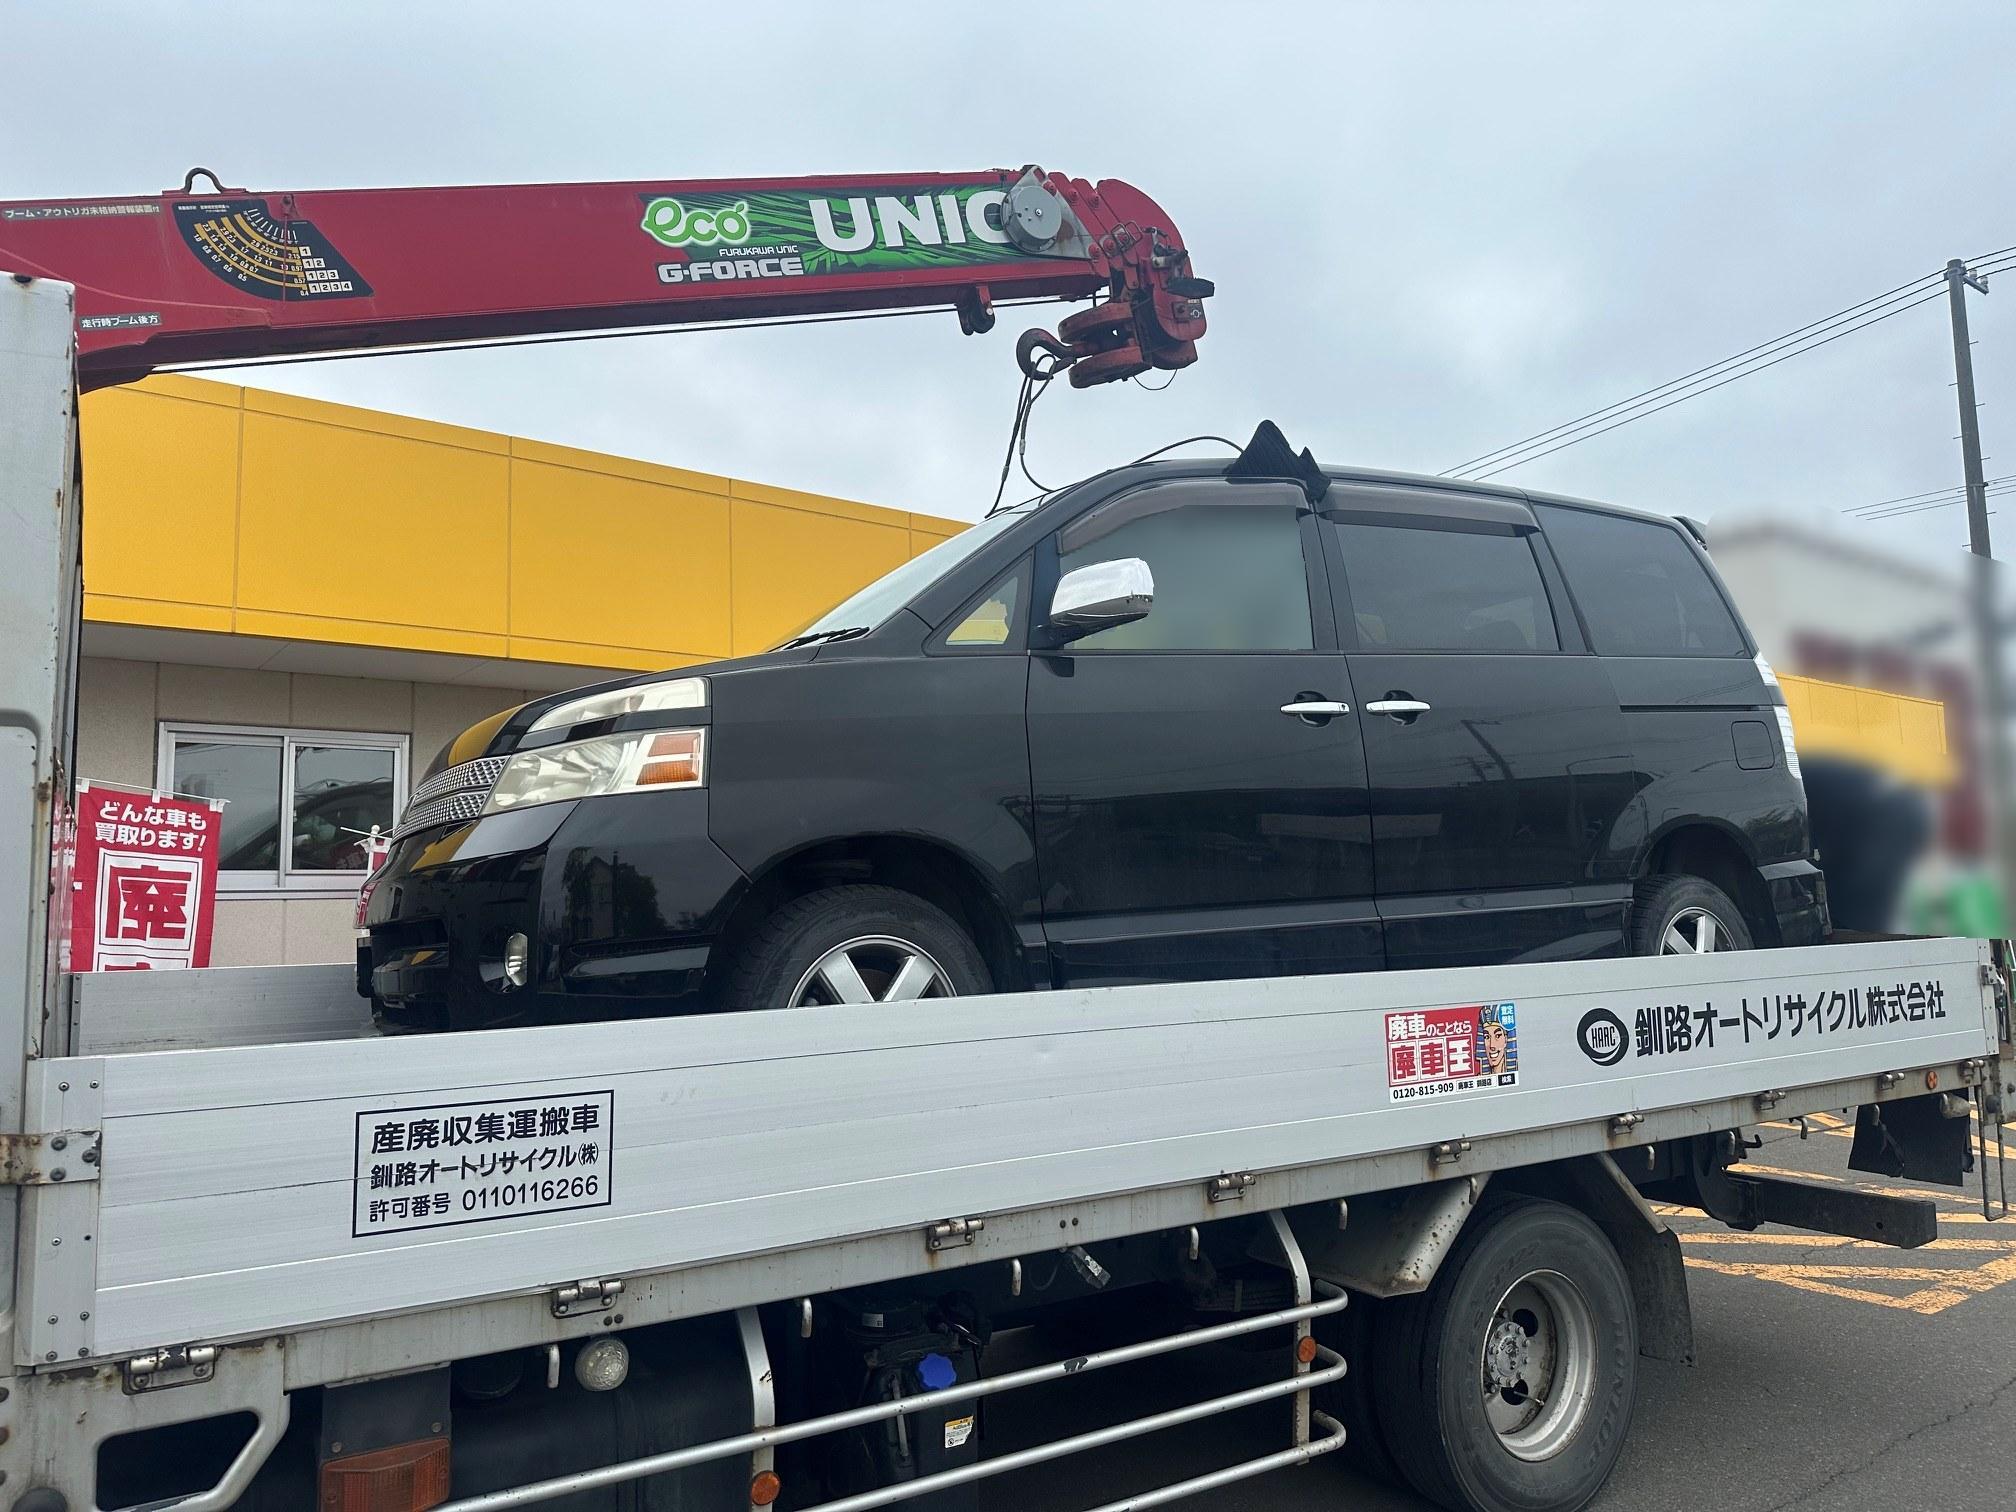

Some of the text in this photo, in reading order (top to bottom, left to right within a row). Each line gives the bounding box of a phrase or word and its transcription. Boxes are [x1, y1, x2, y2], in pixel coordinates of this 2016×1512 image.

[642, 199, 749, 244] eco
[807, 190, 1012, 254] UNIC
[719, 245, 799, 257] FURUKAWA UNIC
[657, 257, 804, 283] G-FORCE
[82, 315, 158, 328] 走行時ブーム後方
[99, 801, 207, 831] どんな車も
[1388, 1013, 1472, 1041] 廃車のことなら
[1634, 981, 1946, 1058] 釧路オートリサイクル株式会社
[1591, 1025, 1616, 1049] HARC
[1391, 1039, 1472, 1080] 廃車王
[1393, 1082, 1454, 1100] 0120-815-909
[371, 1103, 600, 1154] 産廃収集運搬車
[369, 1174, 599, 1223] 許可番号 0110116266
